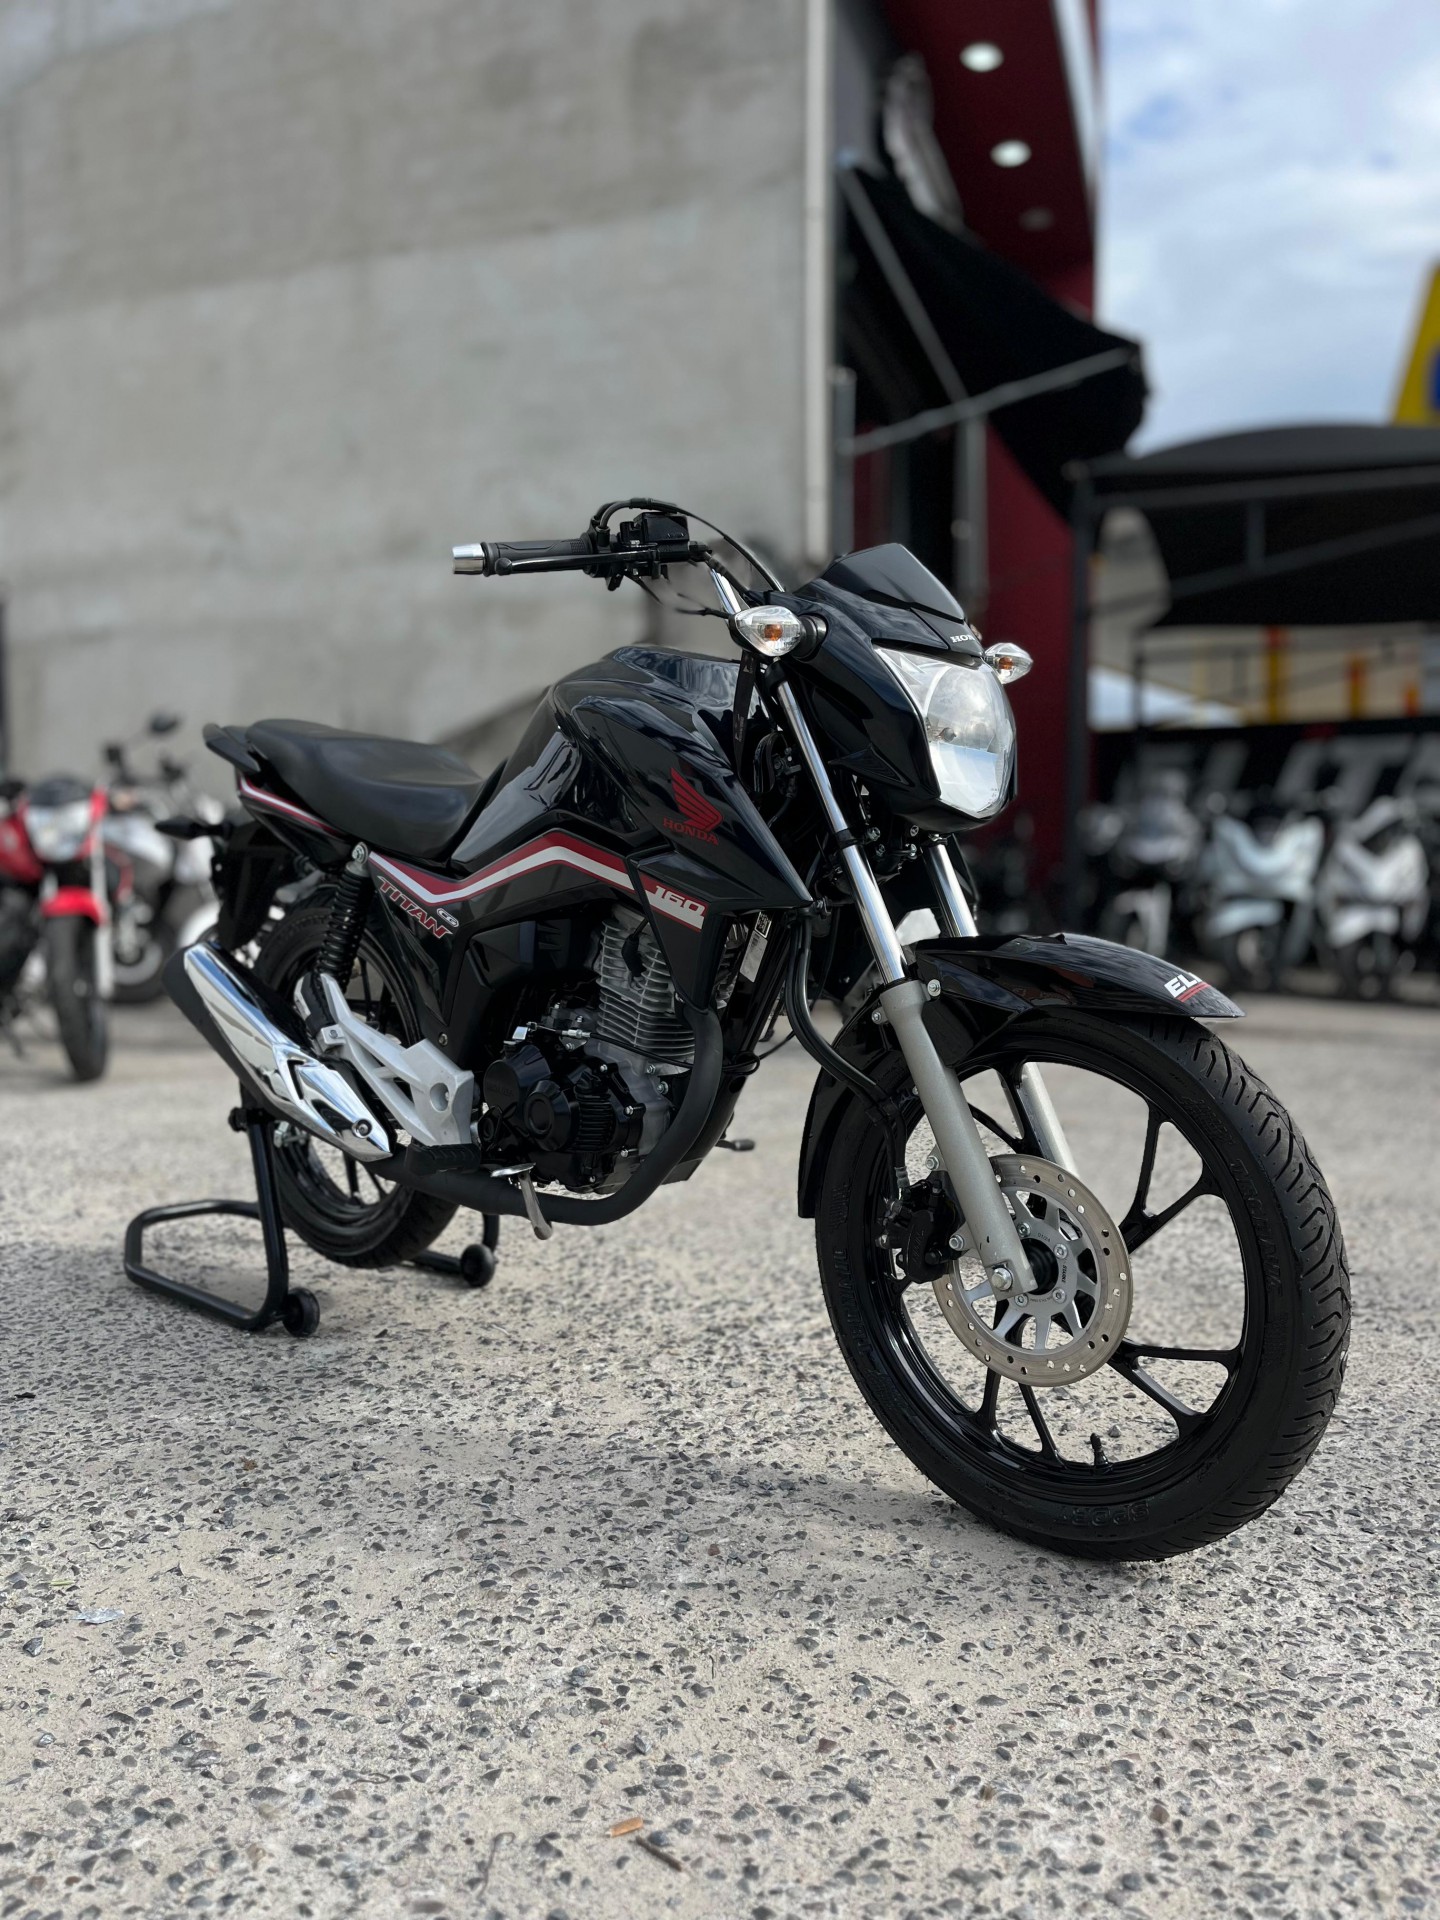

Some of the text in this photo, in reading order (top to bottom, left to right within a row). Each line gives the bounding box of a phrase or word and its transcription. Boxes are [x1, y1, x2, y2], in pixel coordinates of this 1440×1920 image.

[662, 817, 719, 846] HONDA
[377, 875, 454, 940] TITAN
[655, 885, 706, 916] 160
[437, 908, 459, 928] CG
